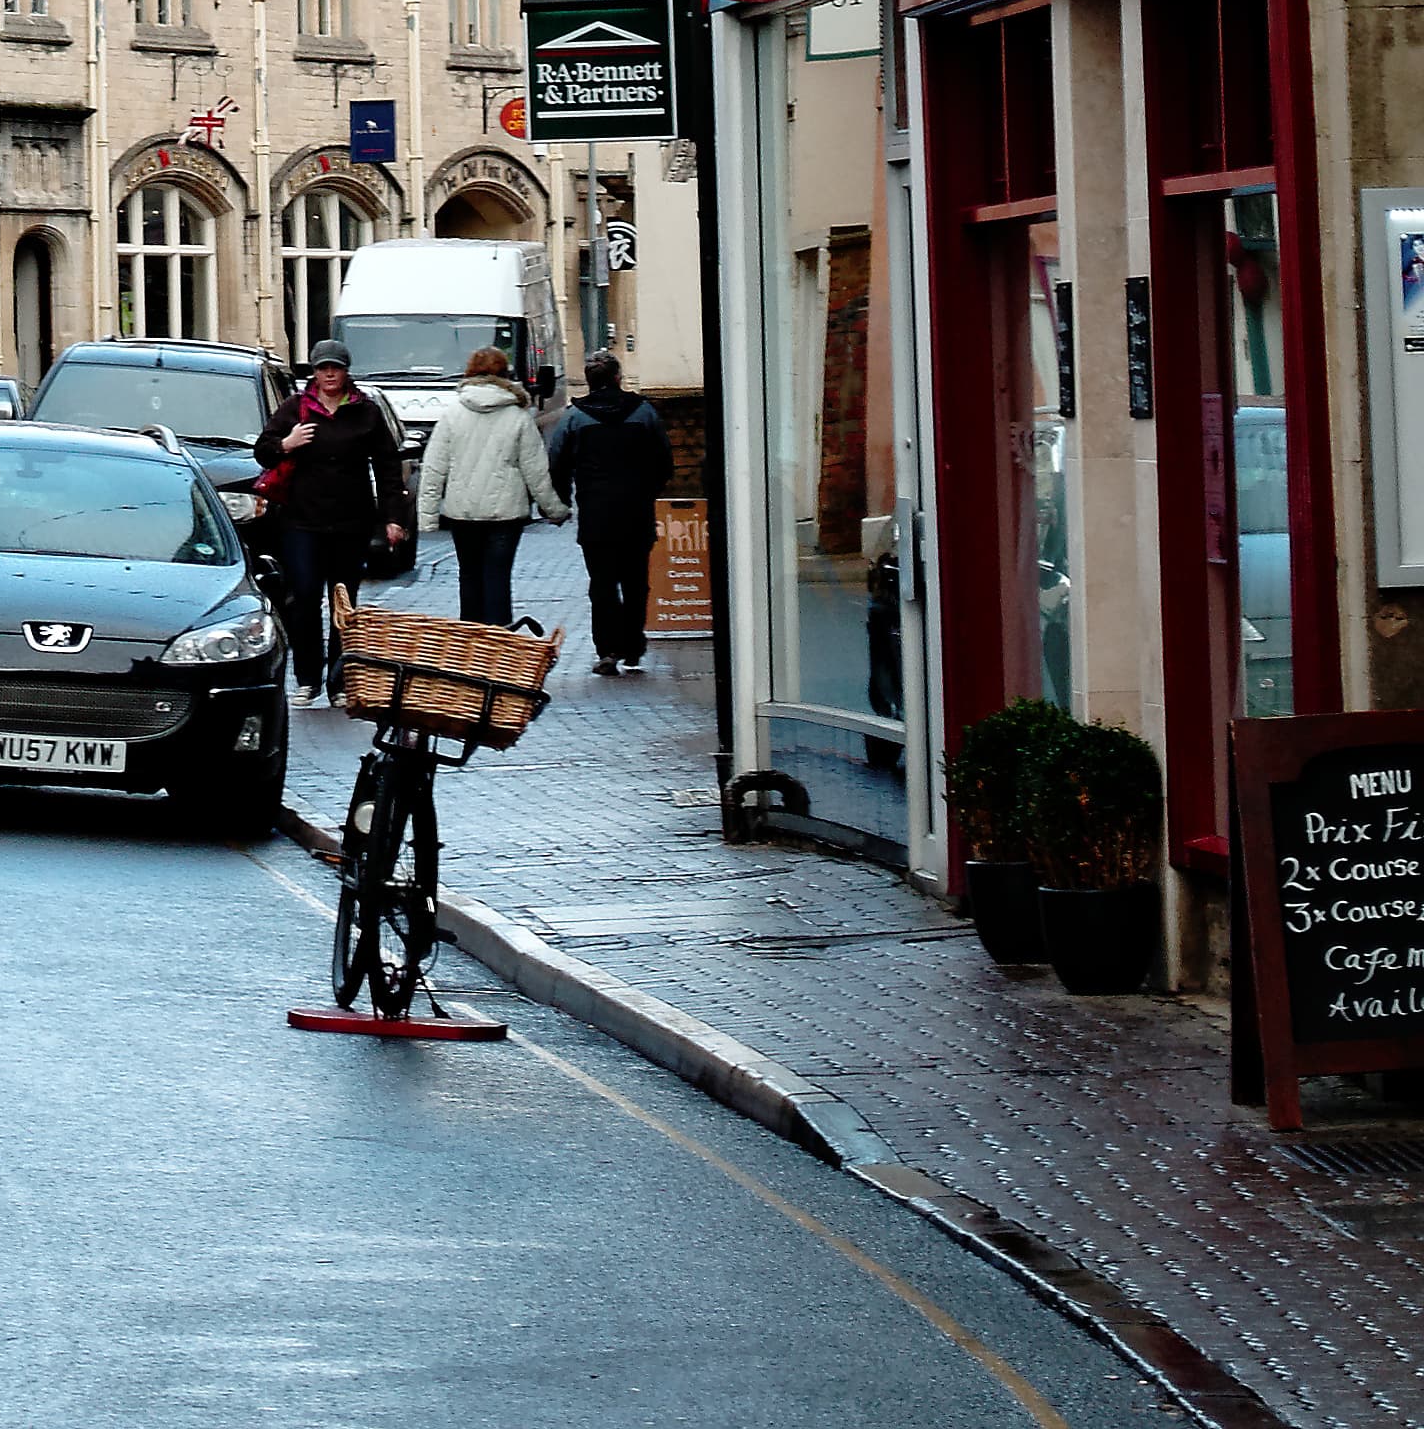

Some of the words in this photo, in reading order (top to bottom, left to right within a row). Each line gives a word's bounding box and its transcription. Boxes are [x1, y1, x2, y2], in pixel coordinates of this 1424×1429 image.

[65, 741, 114, 766] KWW
[1349, 770, 1412, 799] MENU
[1305, 812, 1372, 843] Prix
[1280, 857, 1322, 891] 2x
[1284, 902, 1327, 933] 3x
[1325, 946, 1403, 984] Cafe
